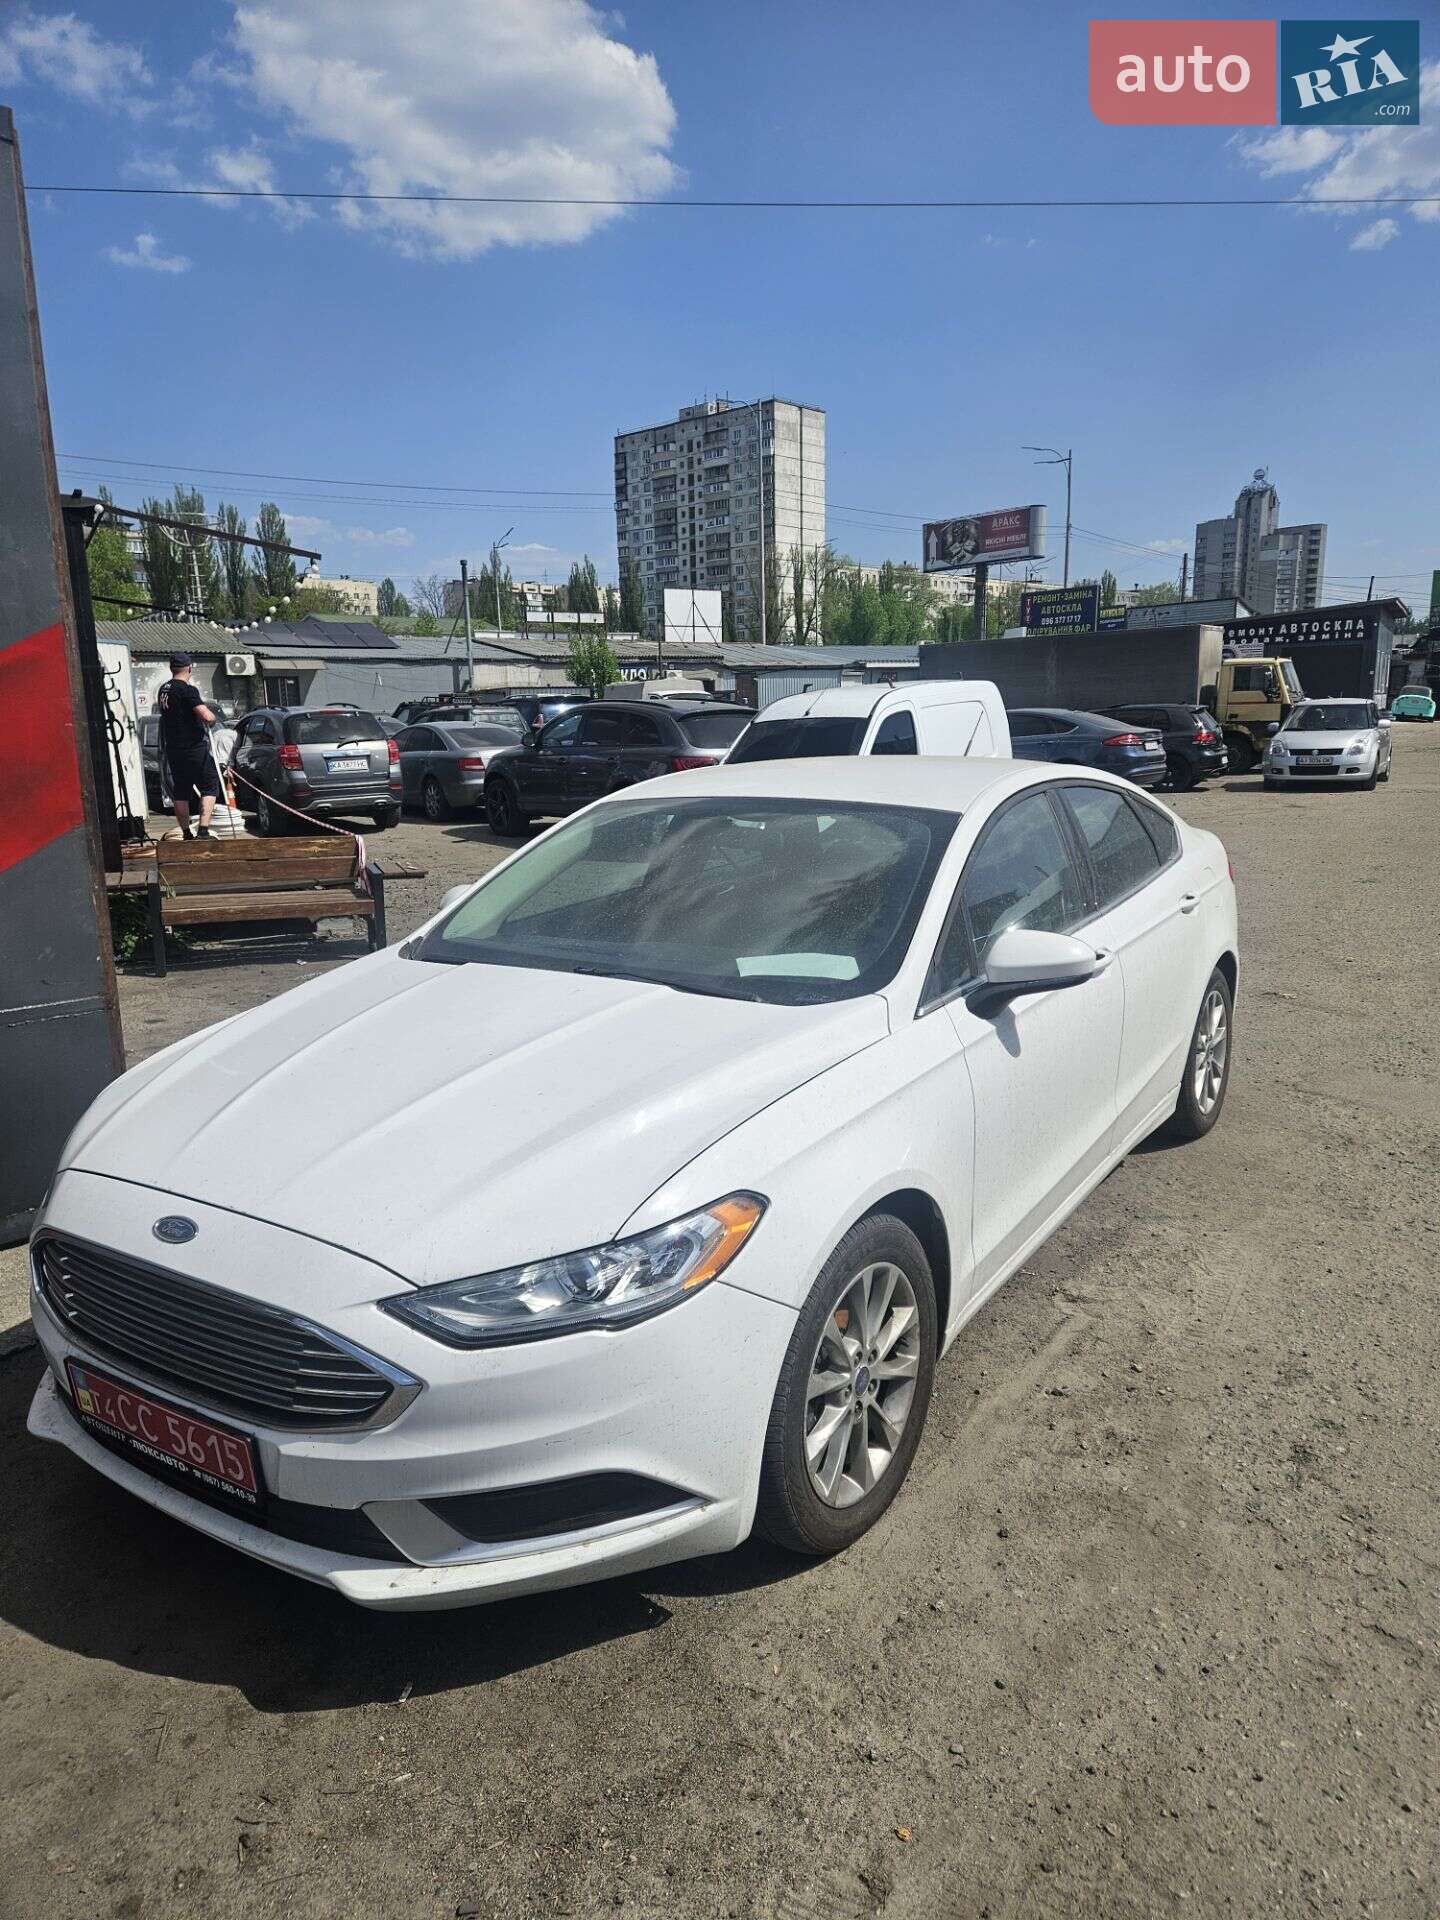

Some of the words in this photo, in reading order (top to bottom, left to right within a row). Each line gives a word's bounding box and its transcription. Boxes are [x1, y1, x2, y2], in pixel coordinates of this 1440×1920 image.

[992, 515, 1020, 528] АРАКС
[1042, 604, 1082, 614] АВТОСКЛА
[1027, 625, 1073, 636] ОЛІРУВАННЯ
[1074, 623, 1091, 633] ФАР
[1227, 627, 1274, 638] емонт
[1279, 619, 1365, 634] АВТОСКЛА
[620, 668, 648, 680] КЛО
[165, 1415, 244, 1480] 5615
